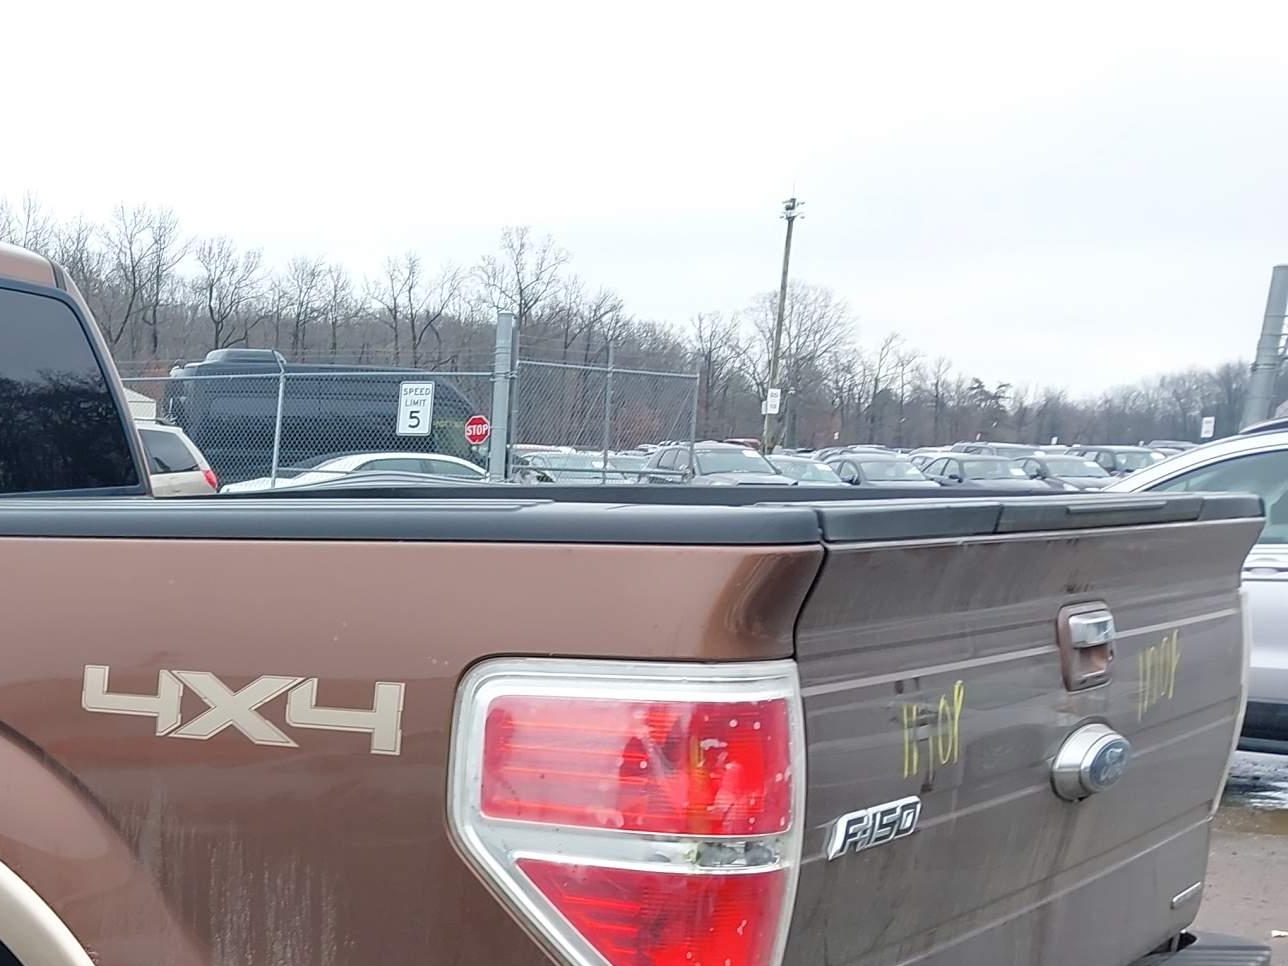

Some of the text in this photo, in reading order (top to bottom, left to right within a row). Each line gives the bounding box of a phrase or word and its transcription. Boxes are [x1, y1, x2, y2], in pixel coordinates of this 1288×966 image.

[403, 387, 431, 396] SPEED
[405, 399, 426, 407] LIMIT
[408, 410, 421, 429] 5
[466, 424, 489, 436] STOP
